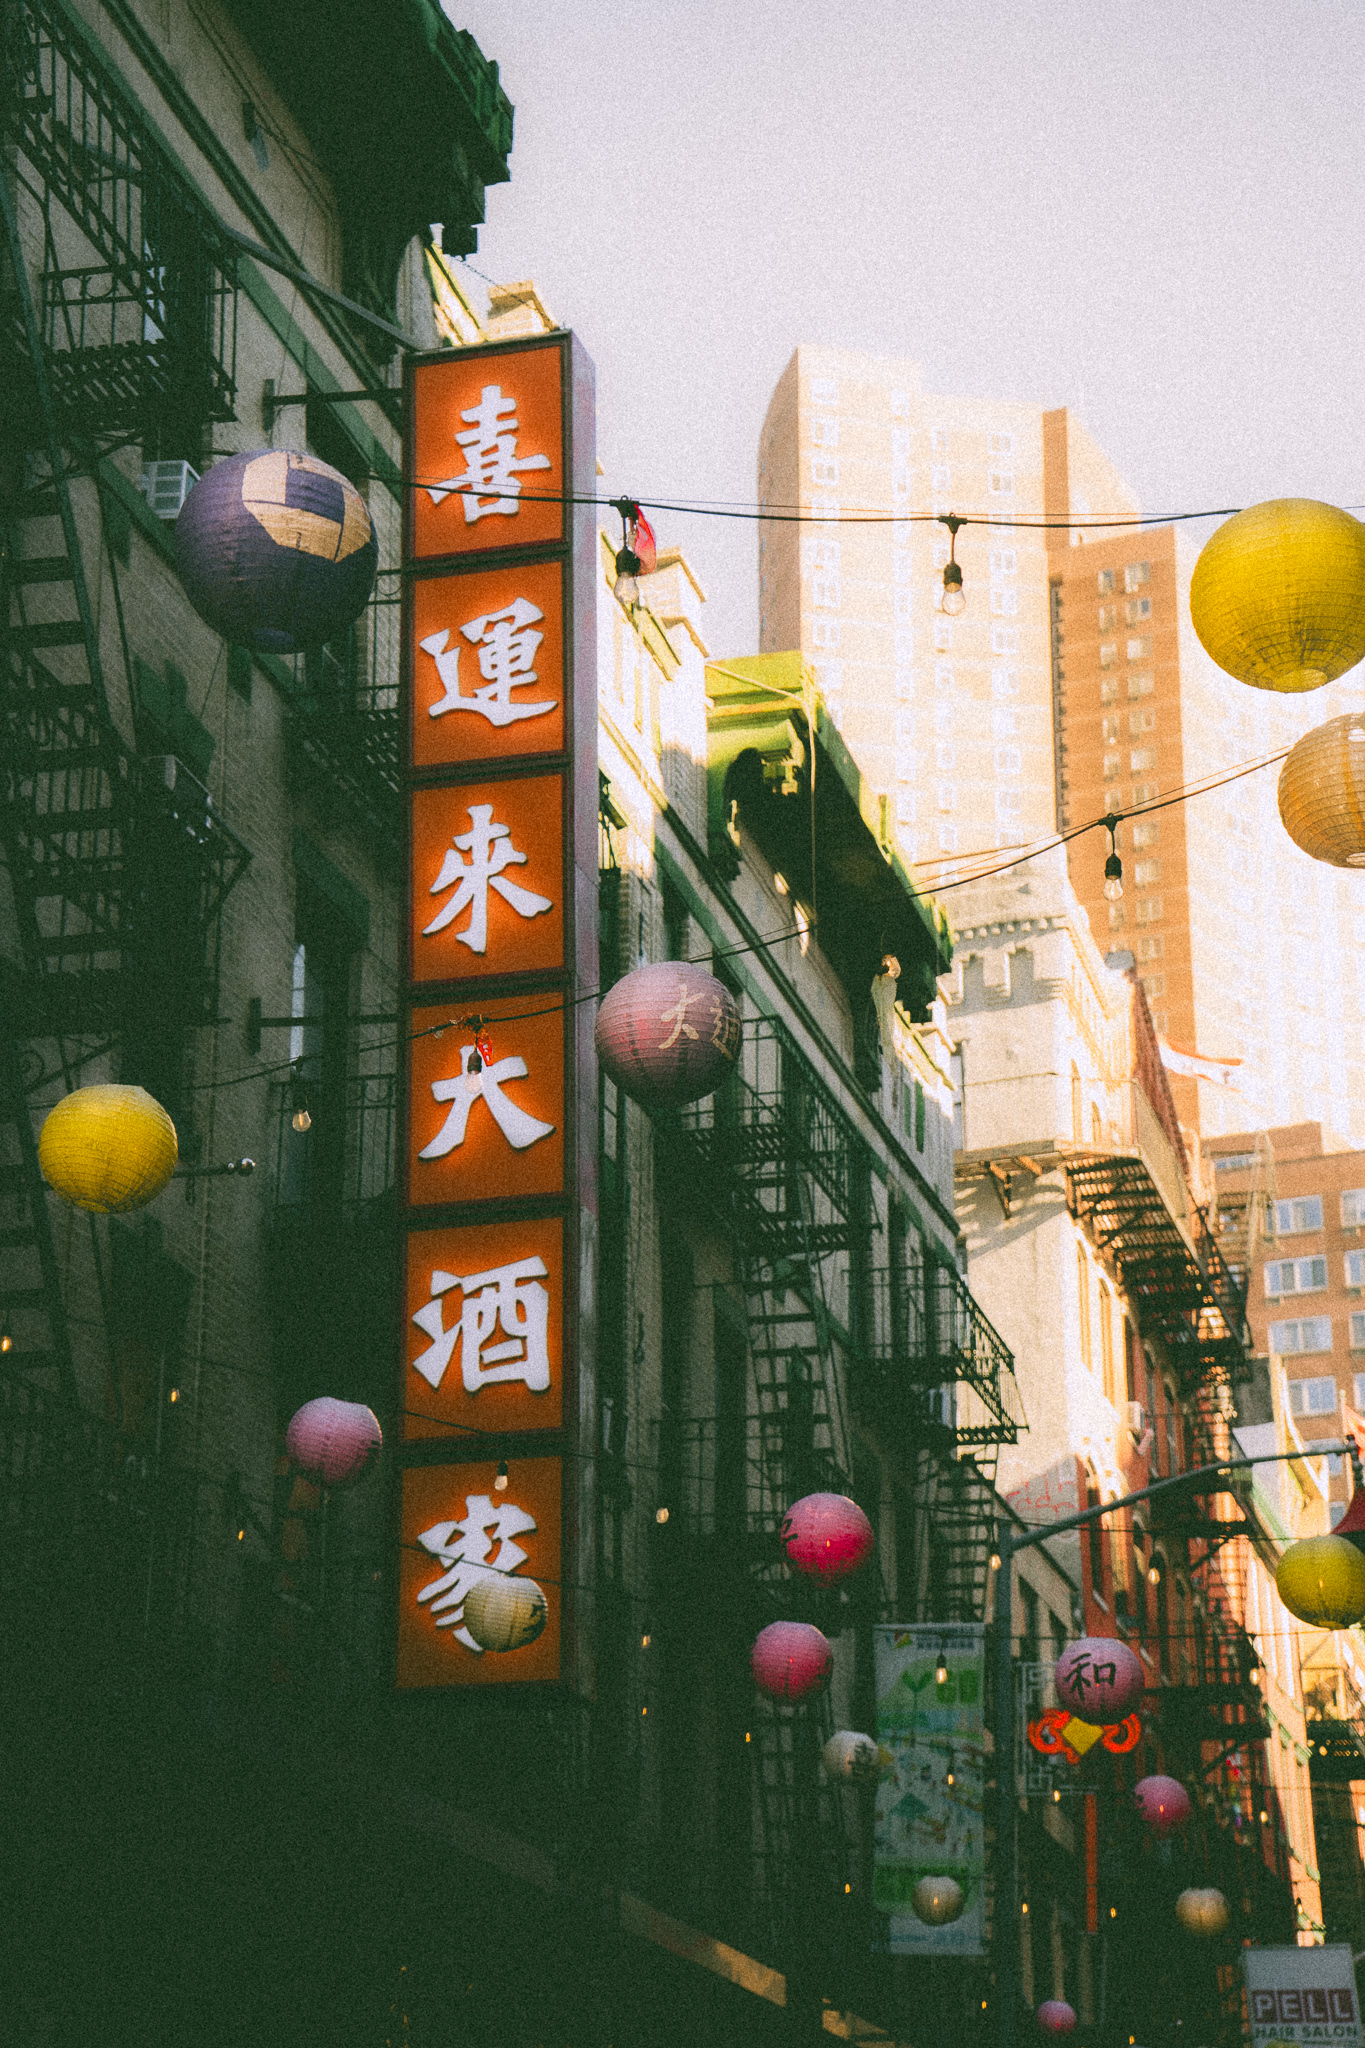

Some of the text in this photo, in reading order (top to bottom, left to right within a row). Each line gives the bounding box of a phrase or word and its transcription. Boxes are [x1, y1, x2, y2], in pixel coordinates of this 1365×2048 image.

[1064, 1653, 1117, 1702] 和
[1254, 1992, 1352, 2019] PELL
[1255, 2025, 1358, 2038] HAIR SALON
